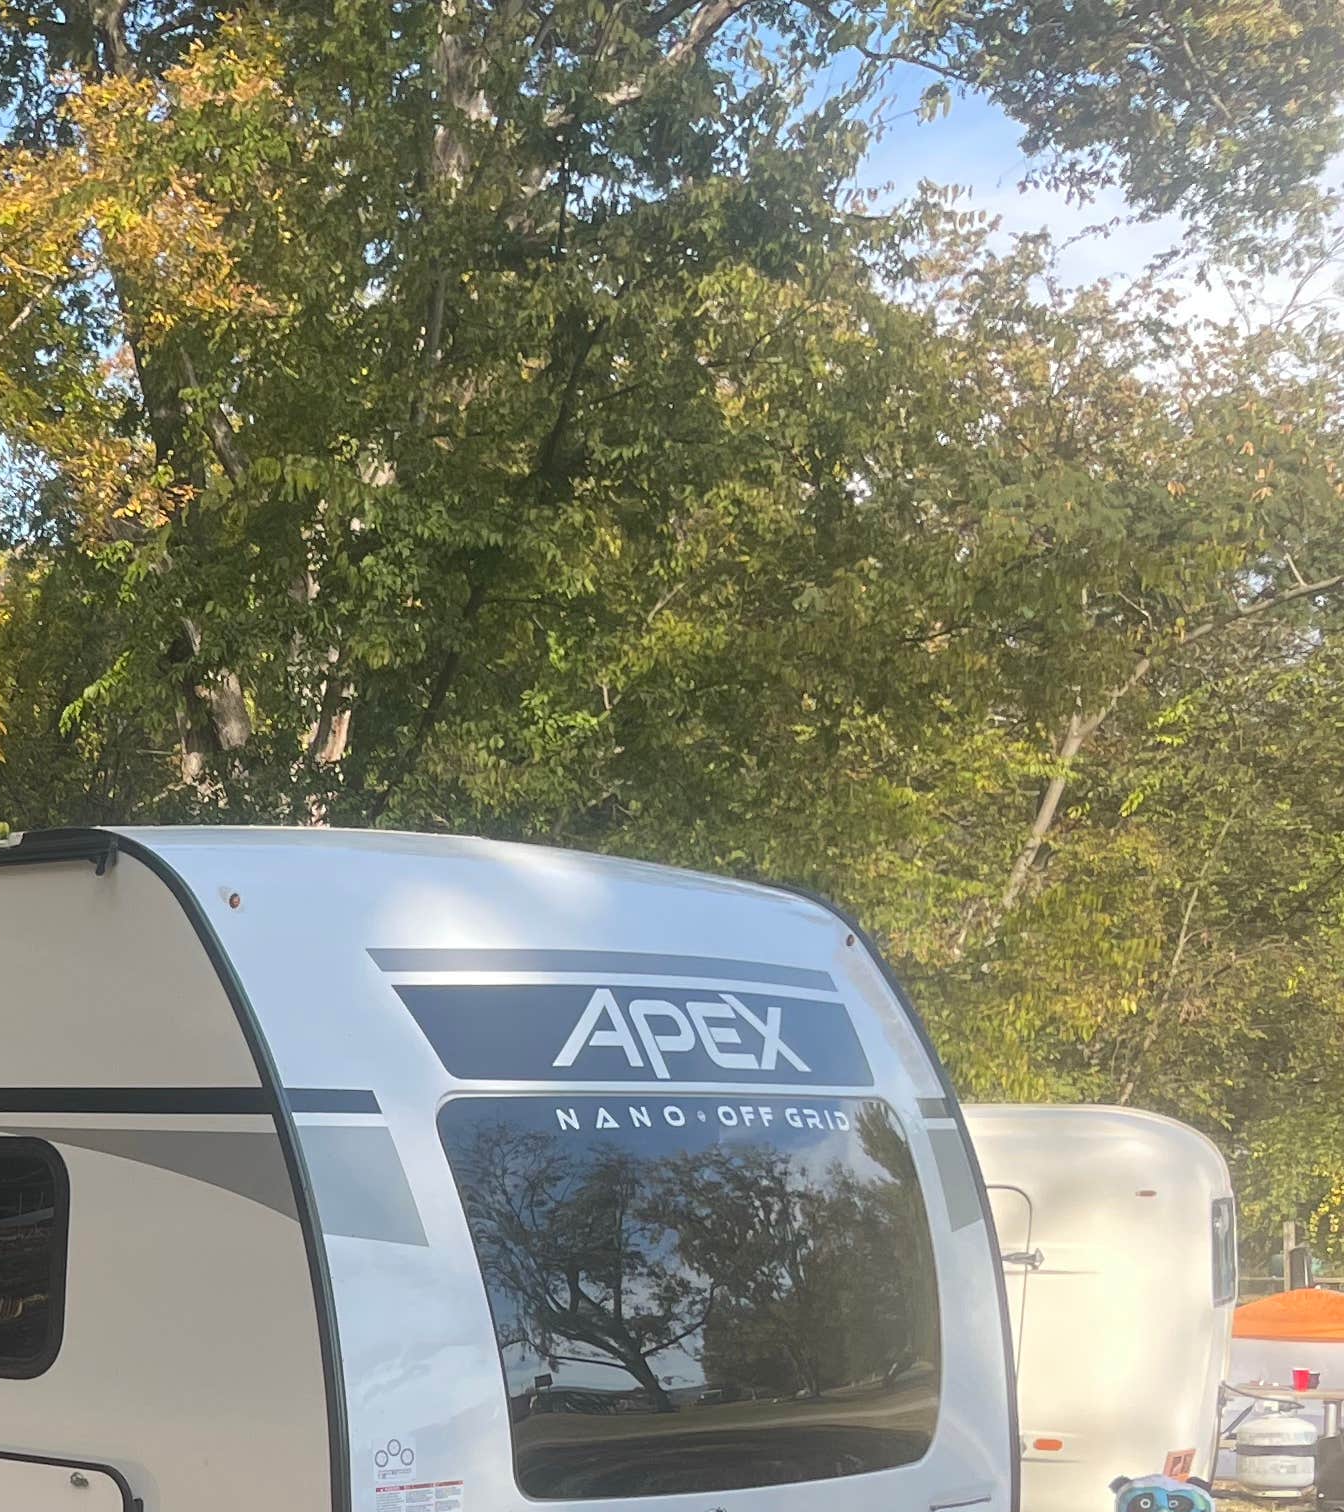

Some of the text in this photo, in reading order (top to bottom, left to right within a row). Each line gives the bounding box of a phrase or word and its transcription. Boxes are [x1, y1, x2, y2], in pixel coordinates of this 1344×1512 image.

[552, 988, 812, 1078] APEX
[555, 1105, 850, 1131] NANO OFF GRID
